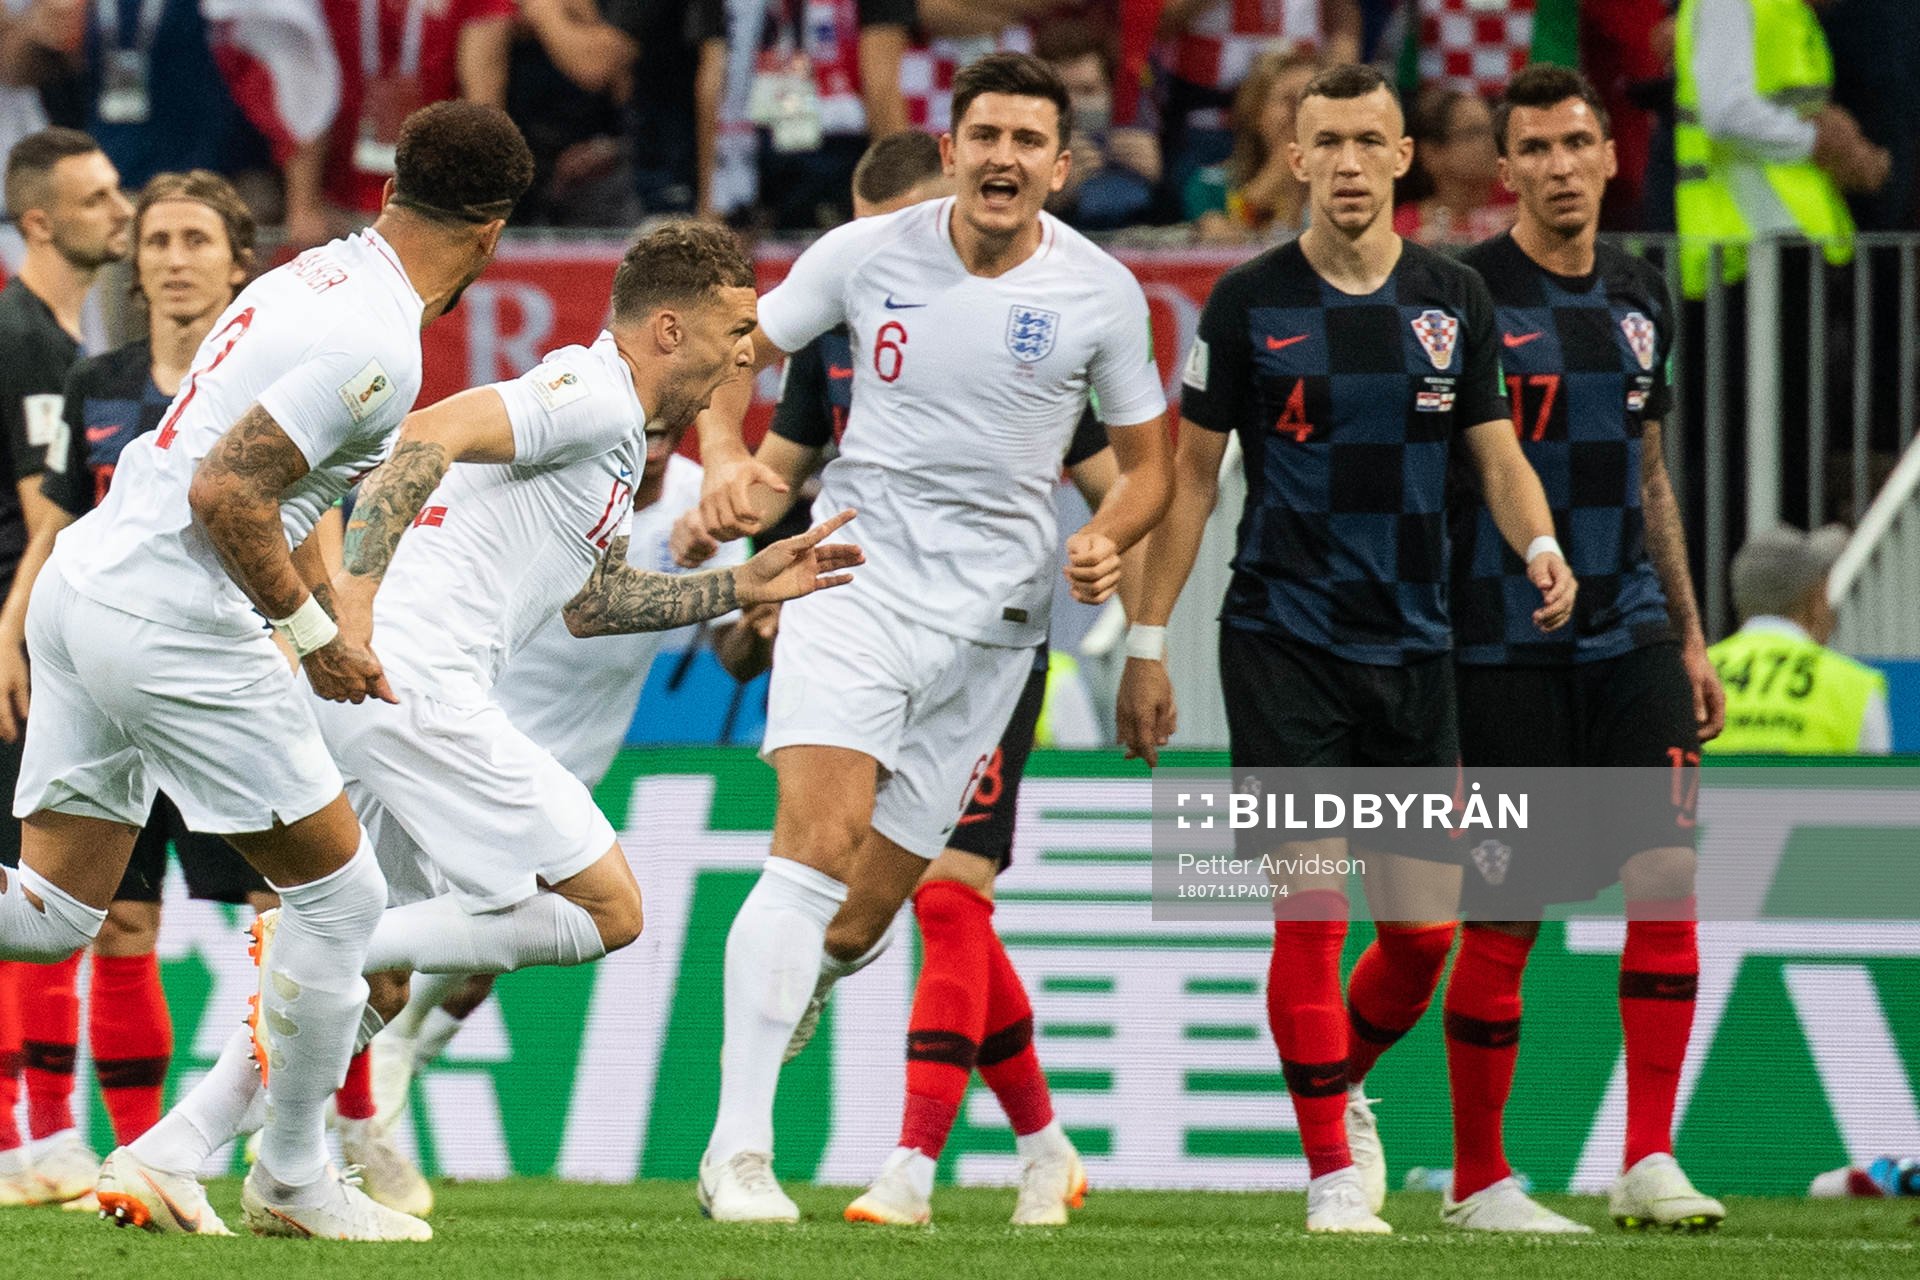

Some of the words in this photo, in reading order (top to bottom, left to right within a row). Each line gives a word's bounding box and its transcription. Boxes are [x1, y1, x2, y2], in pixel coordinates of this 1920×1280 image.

[873, 320, 908, 383] 6
[1275, 377, 1314, 442] 4
[1505, 375, 1560, 442] 17
